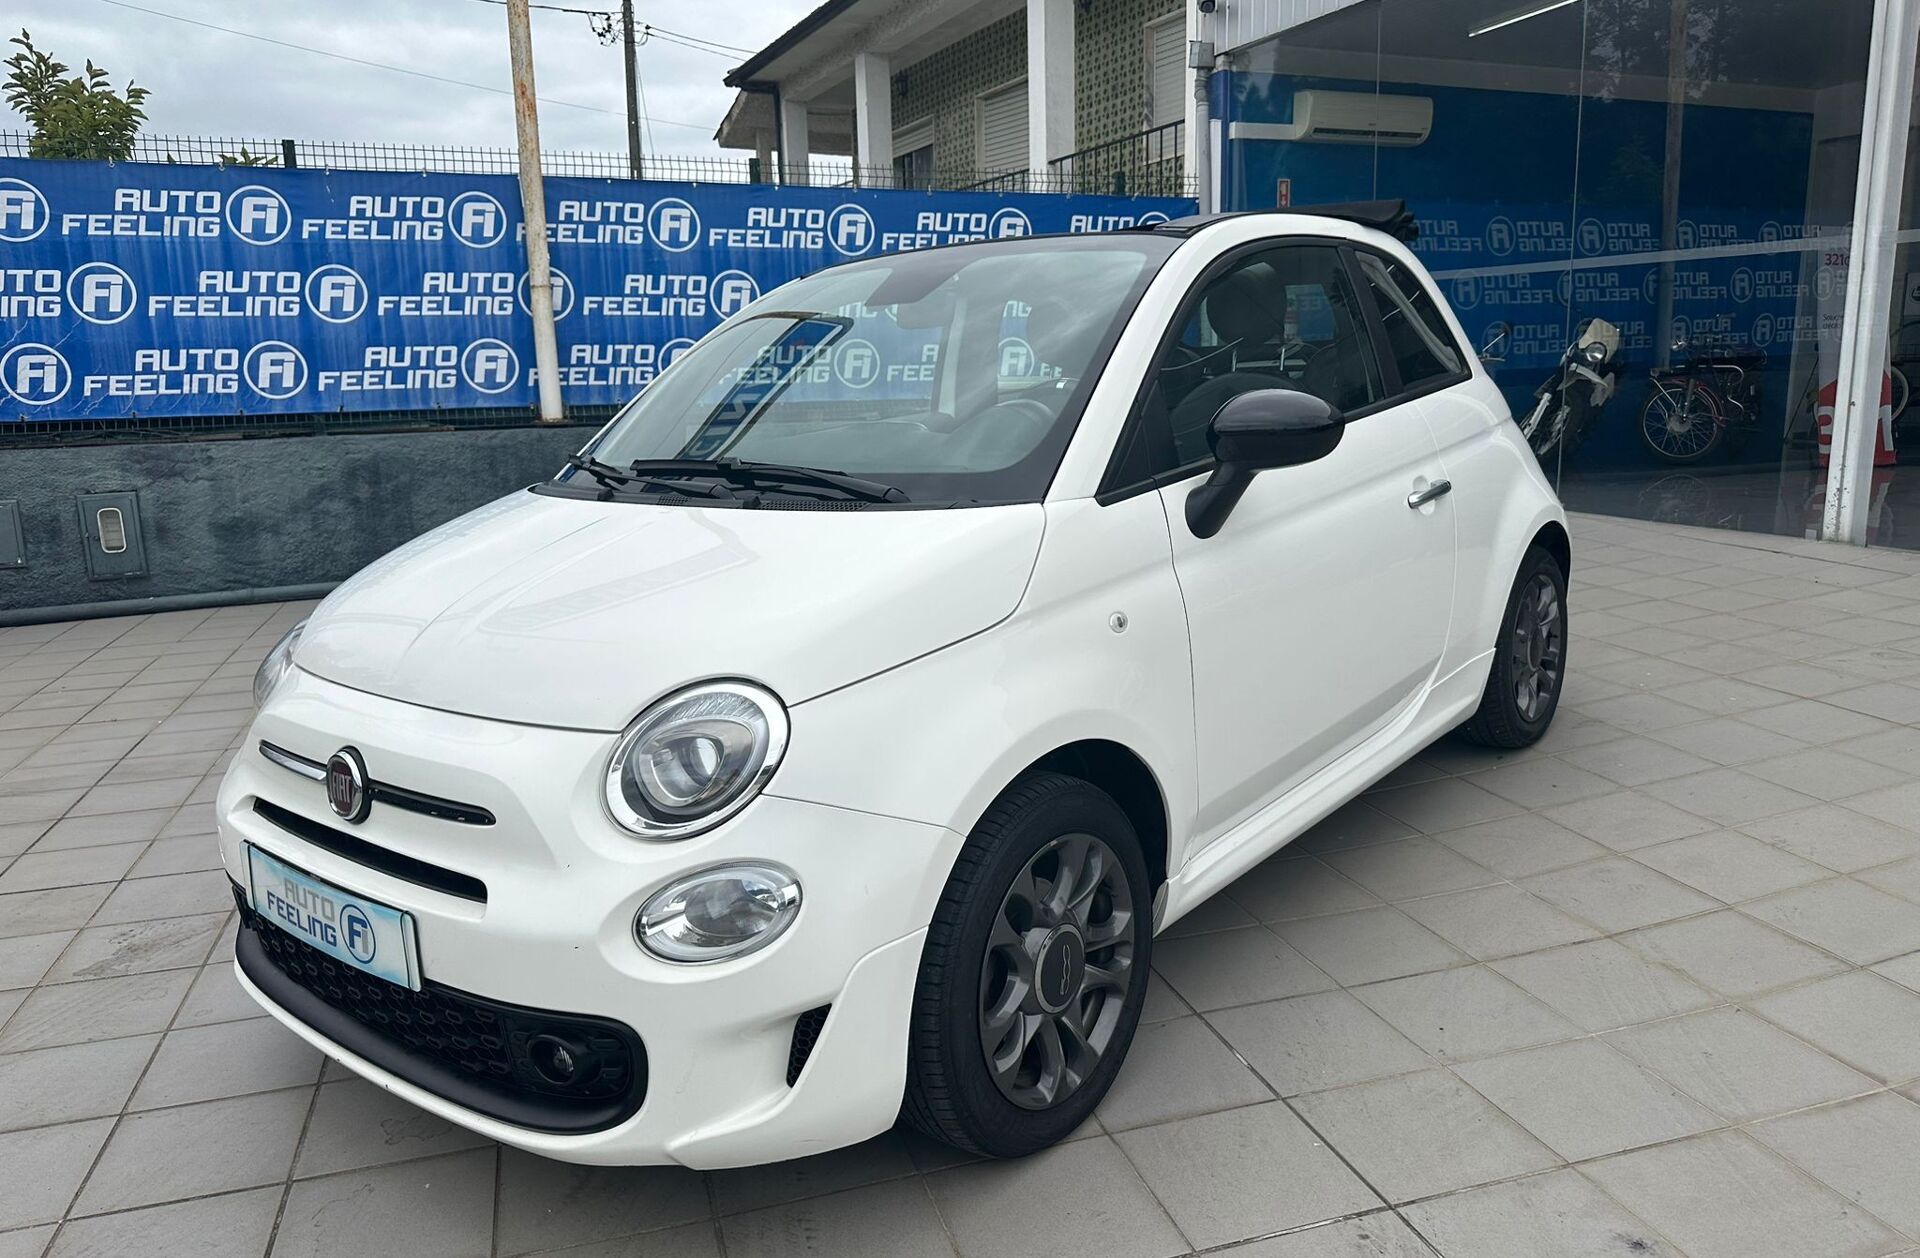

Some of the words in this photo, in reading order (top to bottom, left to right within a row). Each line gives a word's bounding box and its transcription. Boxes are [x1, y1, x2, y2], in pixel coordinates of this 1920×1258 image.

[115, 188, 221, 214] AUTO
[350, 195, 444, 218] AUTO
[558, 200, 645, 224] AUTO
[61, 214, 221, 237] FEELING
[301, 218, 444, 241] FEELING
[747, 207, 825, 229] AUTO
[917, 212, 988, 232] AUTO
[1070, 215, 1134, 233] AUTO
[709, 228, 824, 249] FEELING
[199, 270, 300, 293] AUTO
[423, 272, 514, 293] AUTO
[625, 274, 707, 295] AUTO
[149, 296, 300, 317] FEELING
[378, 296, 513, 316] FEELING
[583, 297, 705, 317] FEELING
[135, 349, 238, 372] AUTO
[365, 345, 457, 368] AUTO
[570, 344, 655, 365] AUTO
[83, 373, 238, 396] FEELING
[318, 369, 457, 391] FEELING
[332, 772, 351, 804] FIAT
[284, 877, 335, 923] AUTO
[267, 890, 337, 948] FEELING
